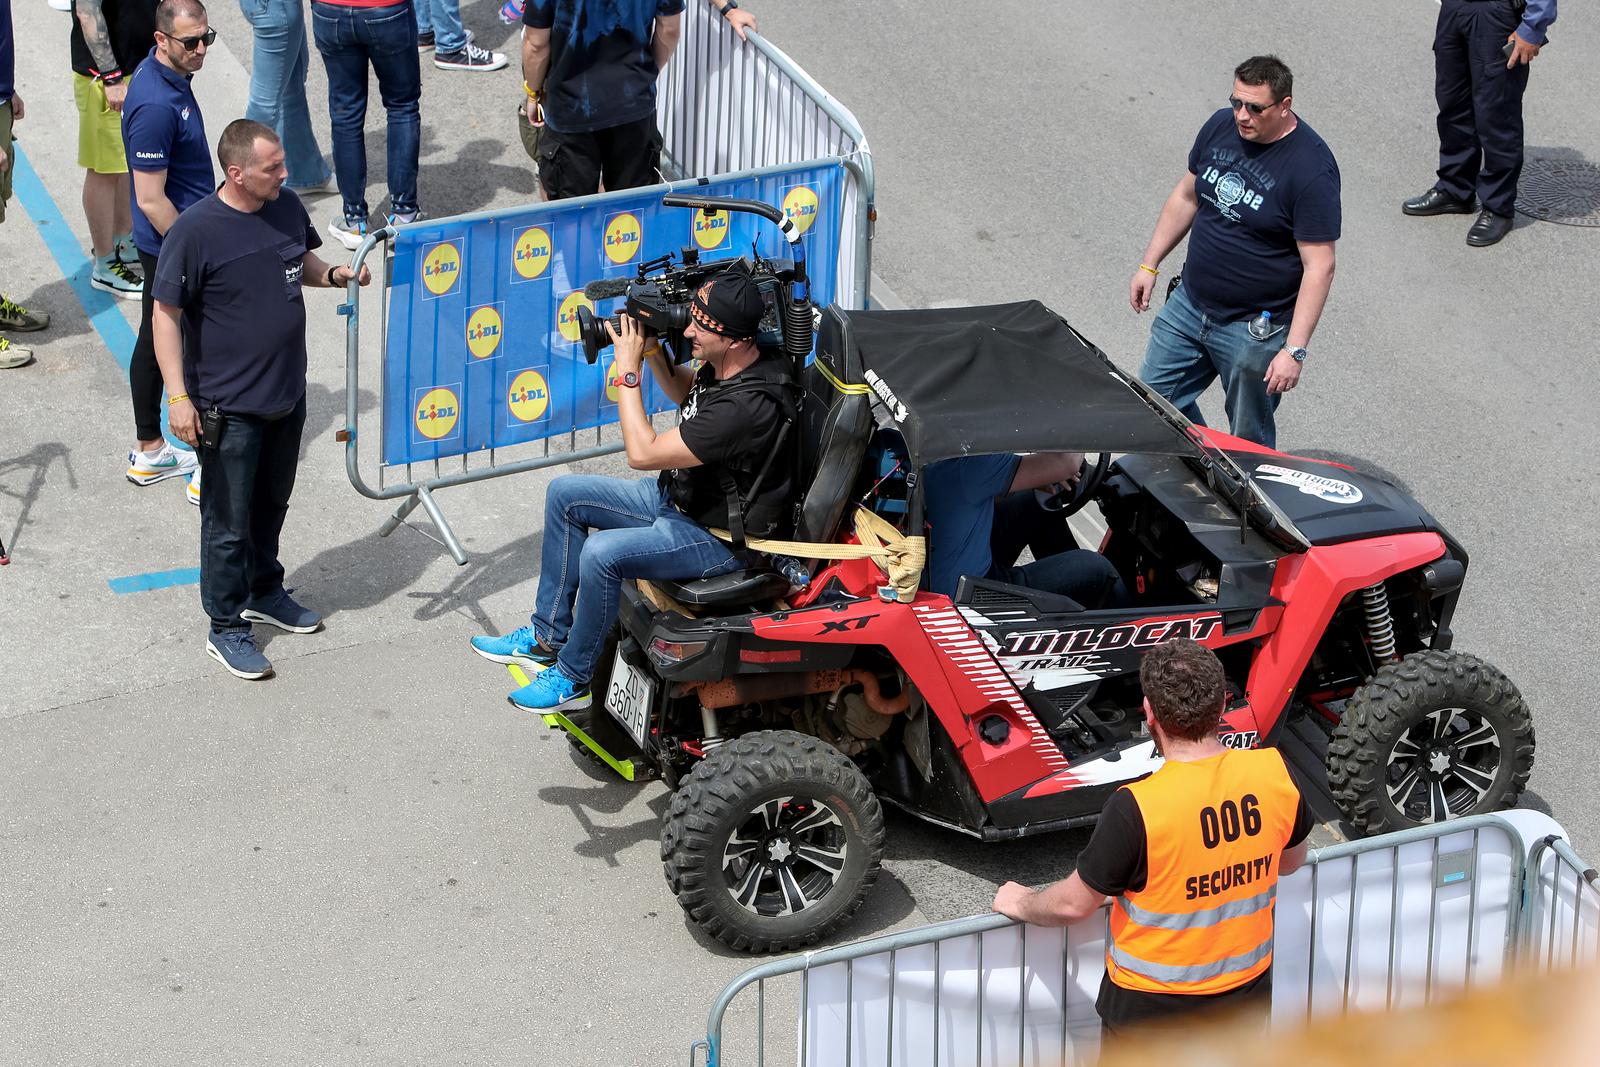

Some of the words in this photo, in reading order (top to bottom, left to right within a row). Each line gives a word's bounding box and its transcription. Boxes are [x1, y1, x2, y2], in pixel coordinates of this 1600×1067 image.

[136, 151, 164, 159] GARMIN
[1201, 166, 1220, 184] 19
[1242, 189, 1264, 211] 62
[785, 202, 816, 219] LIDL
[695, 215, 726, 232] LIDL
[606, 228, 639, 245] LIDL
[516, 243, 550, 261] LIDL
[424, 258, 457, 276] LIDL
[469, 322, 500, 339] LIDL
[511, 386, 546, 404] LIDL
[418, 404, 457, 422] LIDL
[1291, 471, 1345, 491] WORLD
[815, 613, 881, 636] XT
[1005, 615, 1222, 654] WILDCAT
[1016, 655, 1095, 671] TRAIL
[625, 666, 639, 700] ZD
[1200, 794, 1262, 849] 006
[1185, 853, 1273, 900] SECURITY
